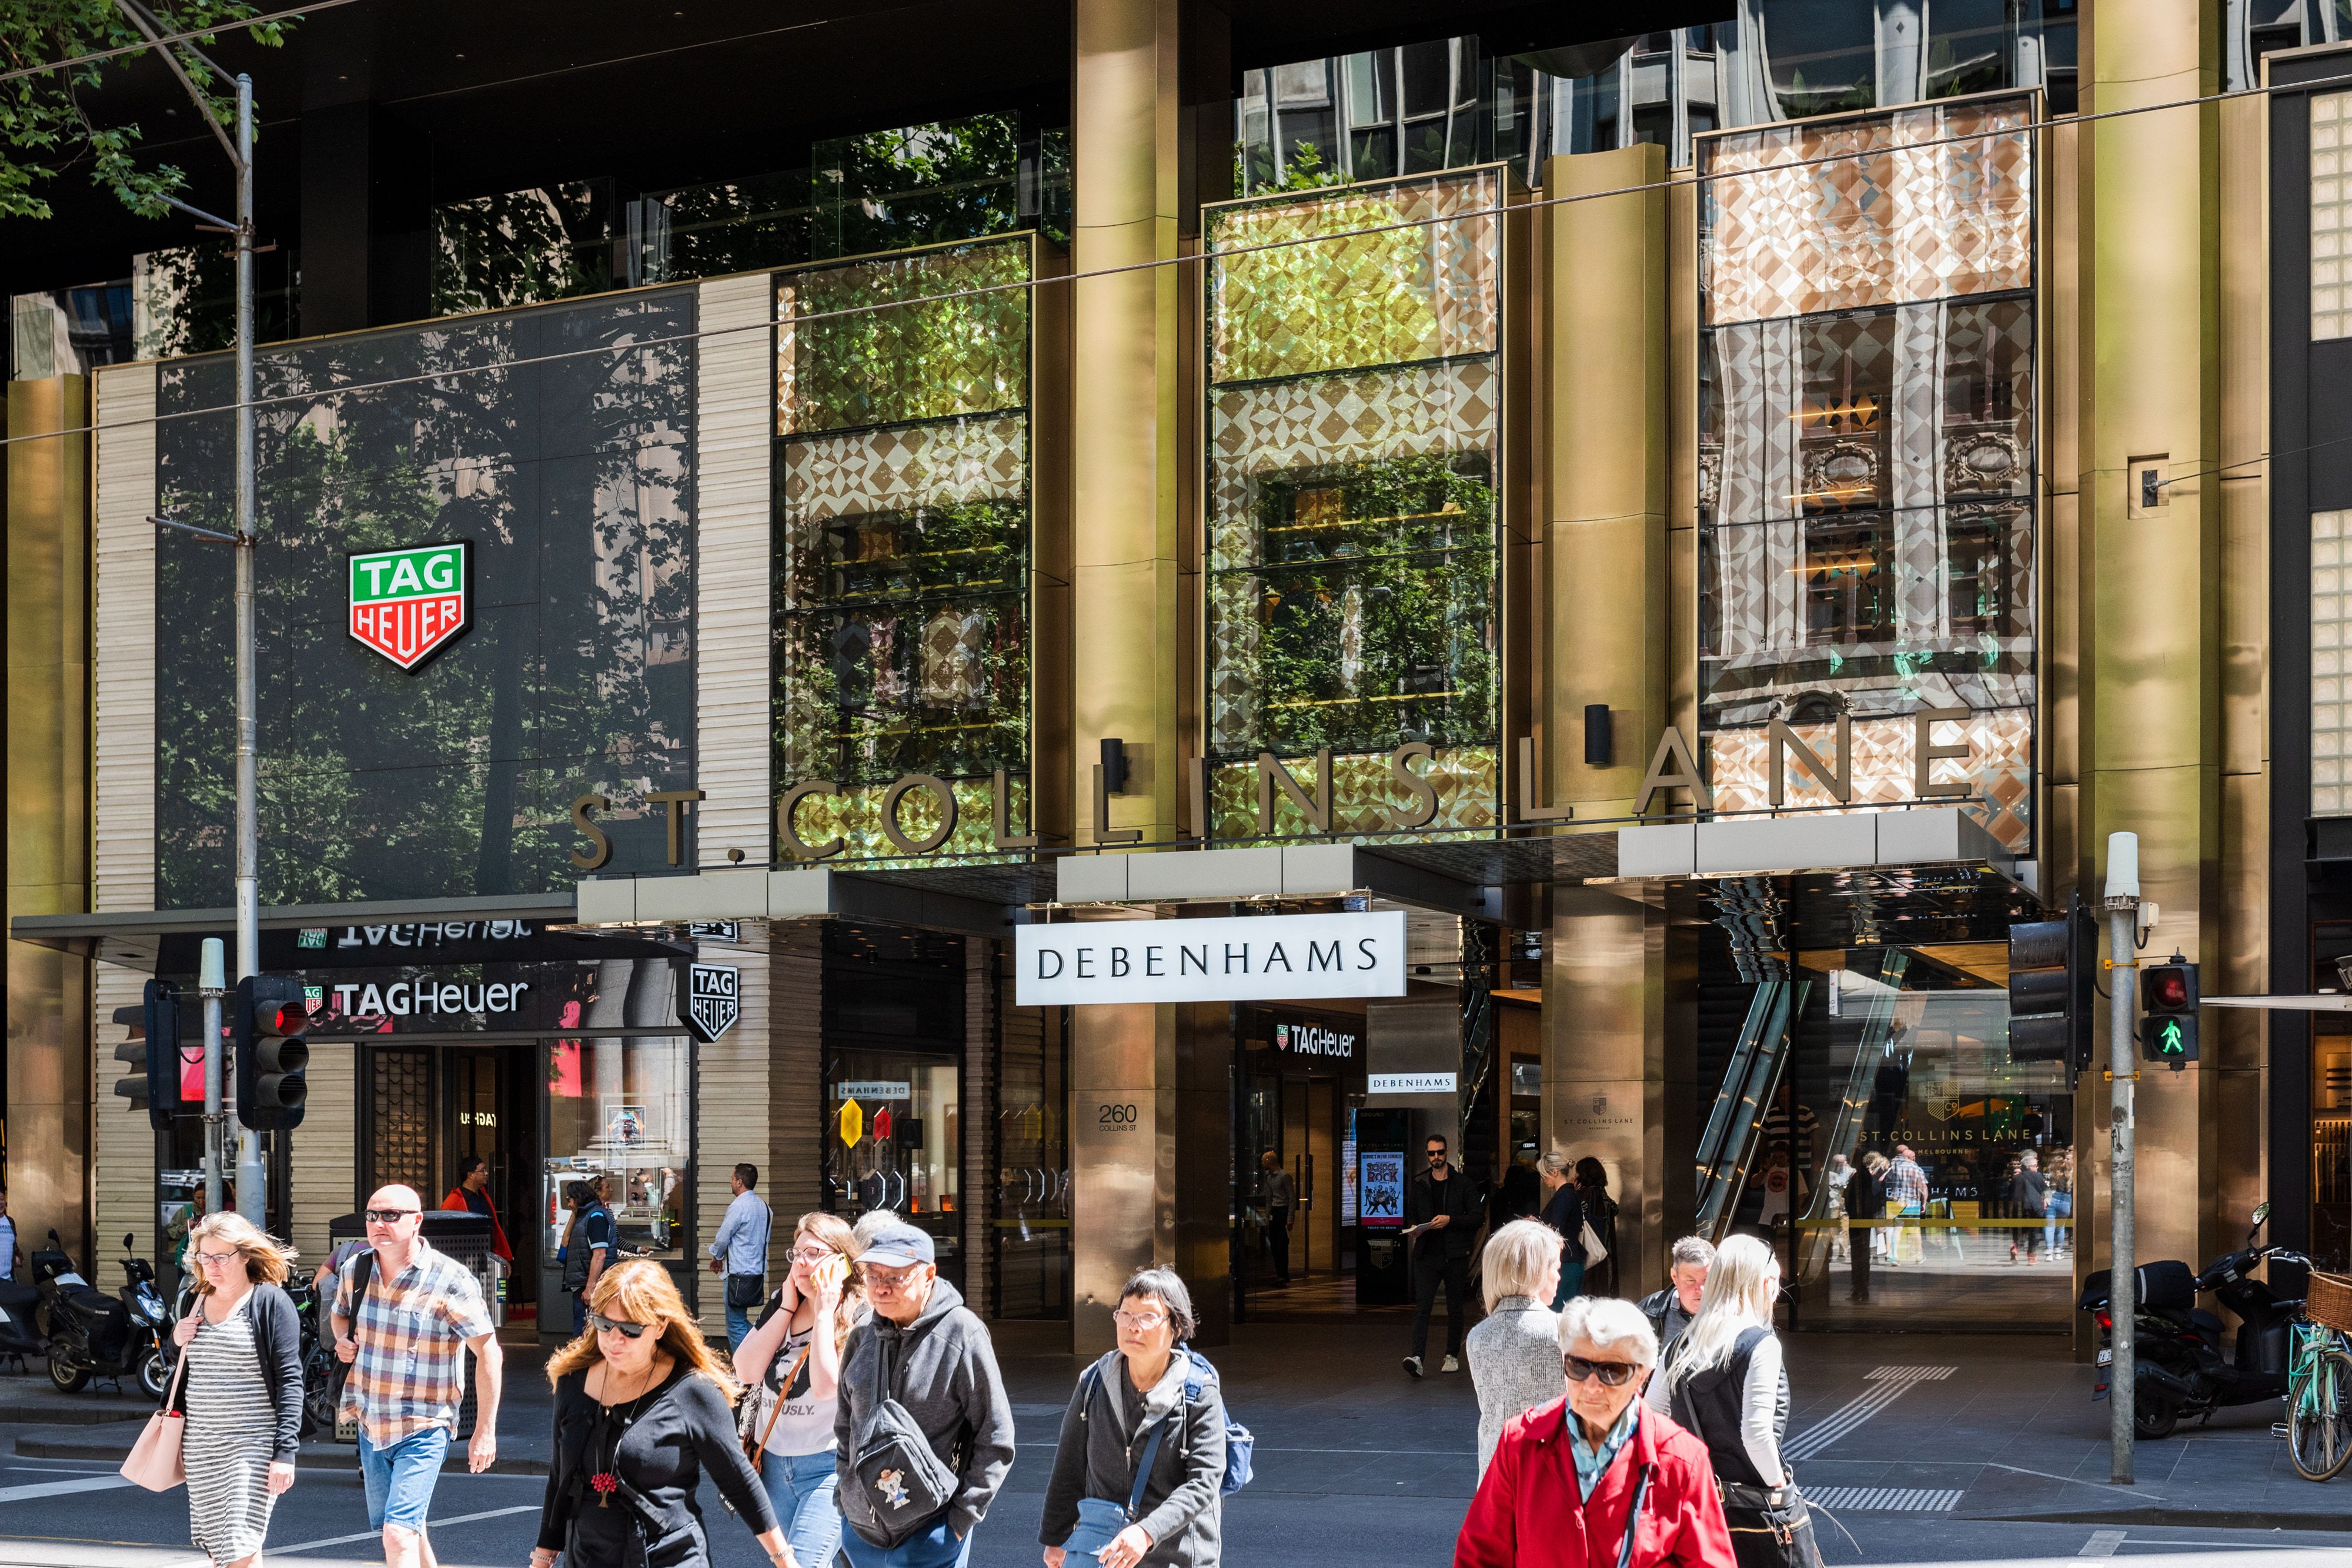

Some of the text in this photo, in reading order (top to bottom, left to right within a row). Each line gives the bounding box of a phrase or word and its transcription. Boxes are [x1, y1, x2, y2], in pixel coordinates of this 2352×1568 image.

[360, 554, 453, 596] TAG
[358, 600, 457, 658] HEUER
[777, 741, 1439, 858] COLLINS
[1519, 707, 1972, 821] LANE
[1037, 938, 1377, 979] DEBENHAMS
[305, 988, 320, 998] AG
[696, 971, 733, 994] TAG
[306, 1000, 320, 1014] UER
[335, 982, 529, 1016] TAGHeuer
[694, 999, 734, 1034] HEUER
[1291, 1025, 1355, 1057] TAGHeuer
[1374, 1078, 1451, 1088] DEBENHAMS
[1099, 1105, 1137, 1124] 260
[1860, 1129, 2031, 1142] ST. COLLINS LANE
[1367, 1162, 1399, 1172] SCHOOL
[1367, 1171, 1398, 1182] ROCK
